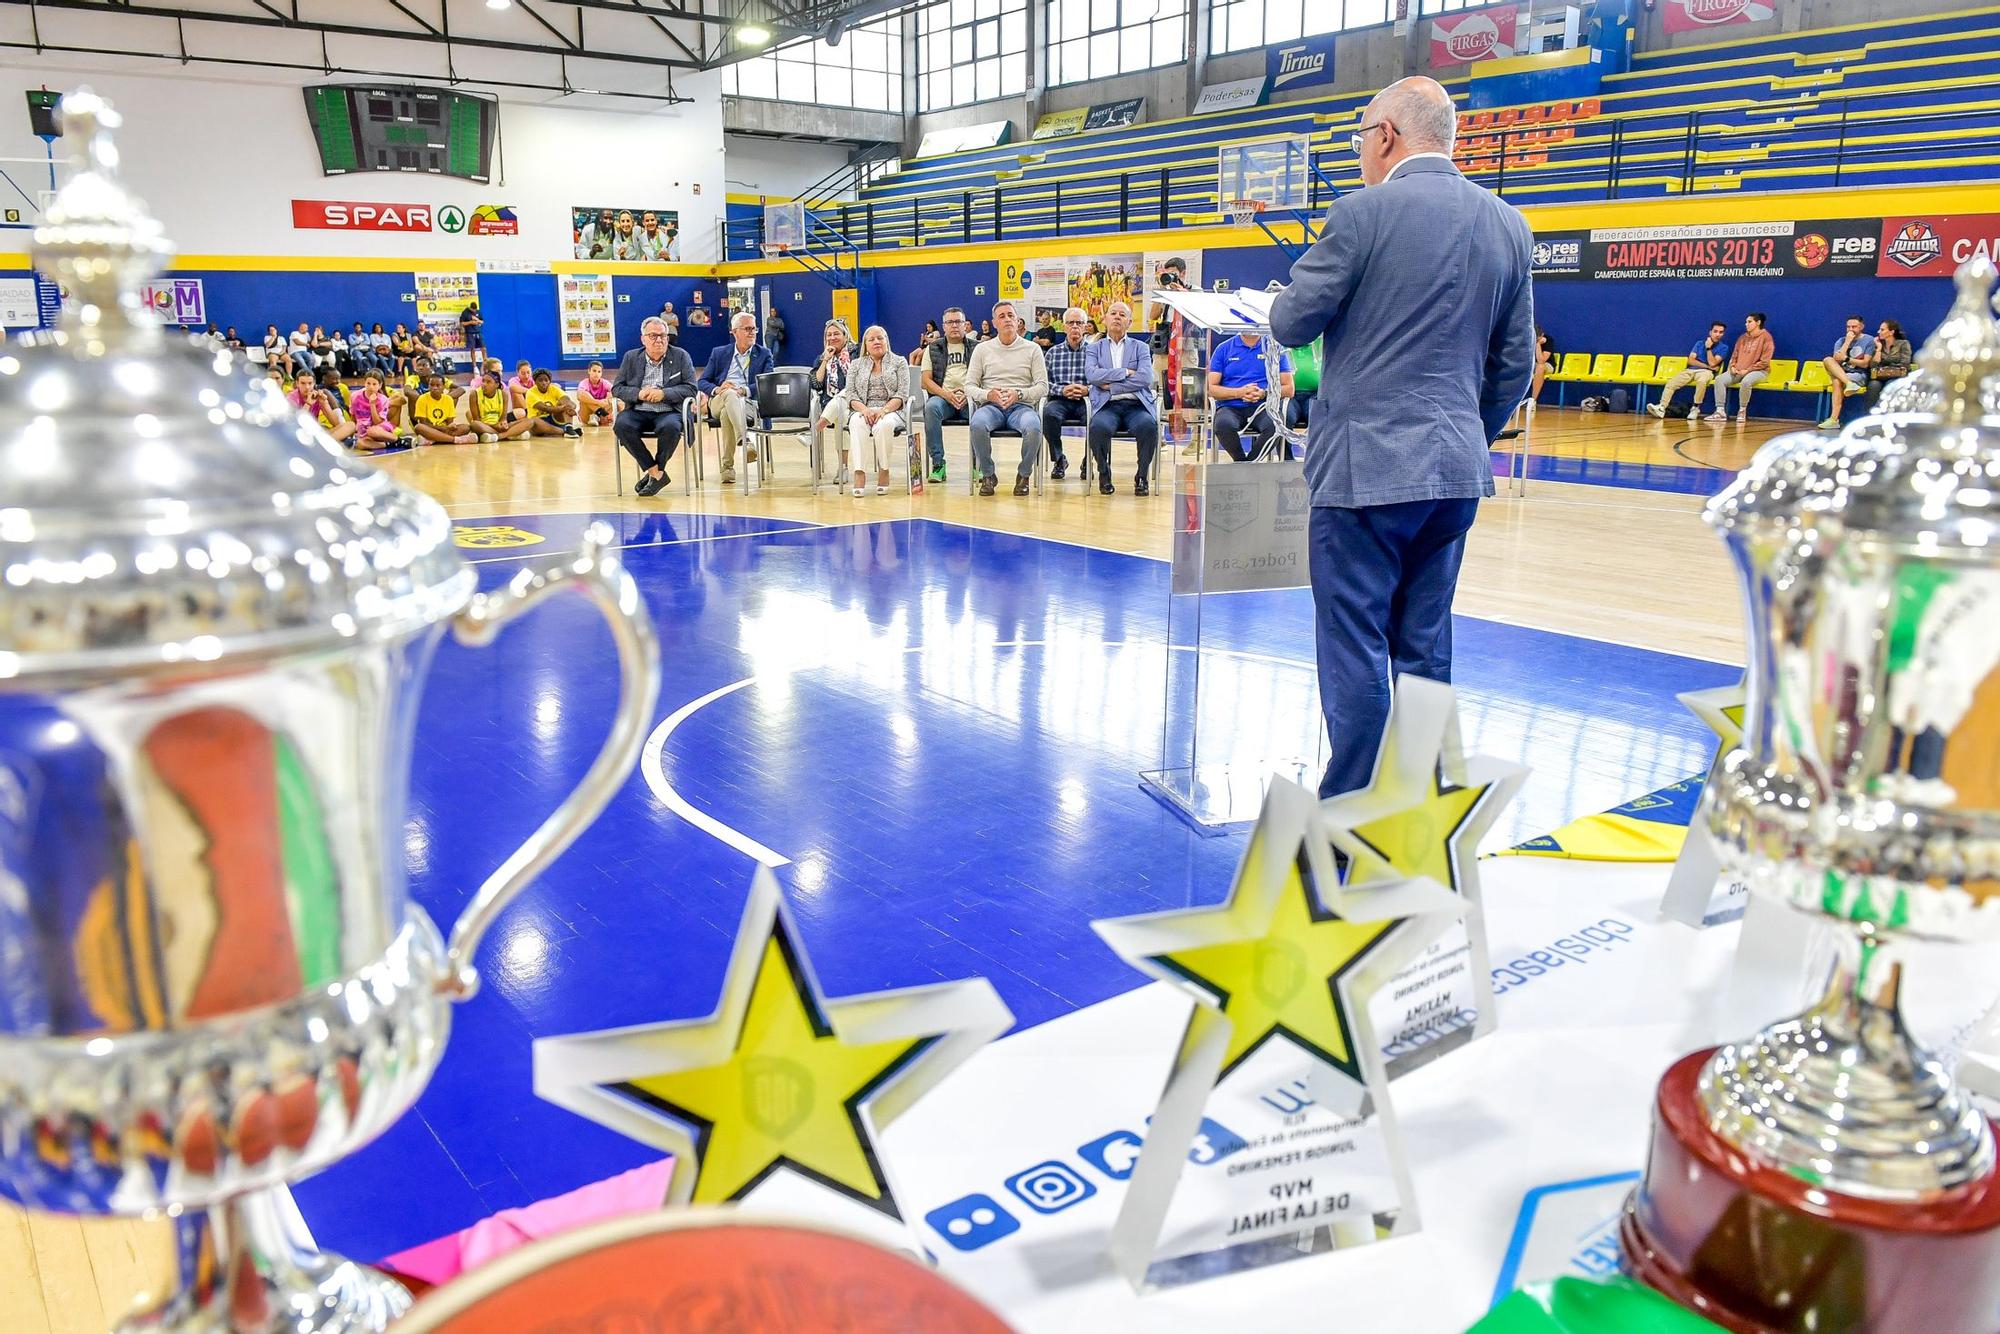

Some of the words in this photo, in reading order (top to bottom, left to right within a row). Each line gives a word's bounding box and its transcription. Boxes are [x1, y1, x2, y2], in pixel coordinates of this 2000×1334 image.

[1449, 30, 1497, 51] FIRGAS
[1279, 45, 1326, 73] Tirma
[324, 205, 430, 228] SPAR
[1606, 240, 1717, 268] CAMPEONAS
[1722, 238, 1775, 266] 2013
[1594, 269, 1638, 279] CAMPEONATO
[1639, 270, 1649, 278] DE
[1649, 268, 1675, 278] ESPAÑA
[1677, 269, 1686, 278] DE
[1687, 268, 1713, 277] CLUBES
[1713, 267, 1744, 277] INFANTIL
